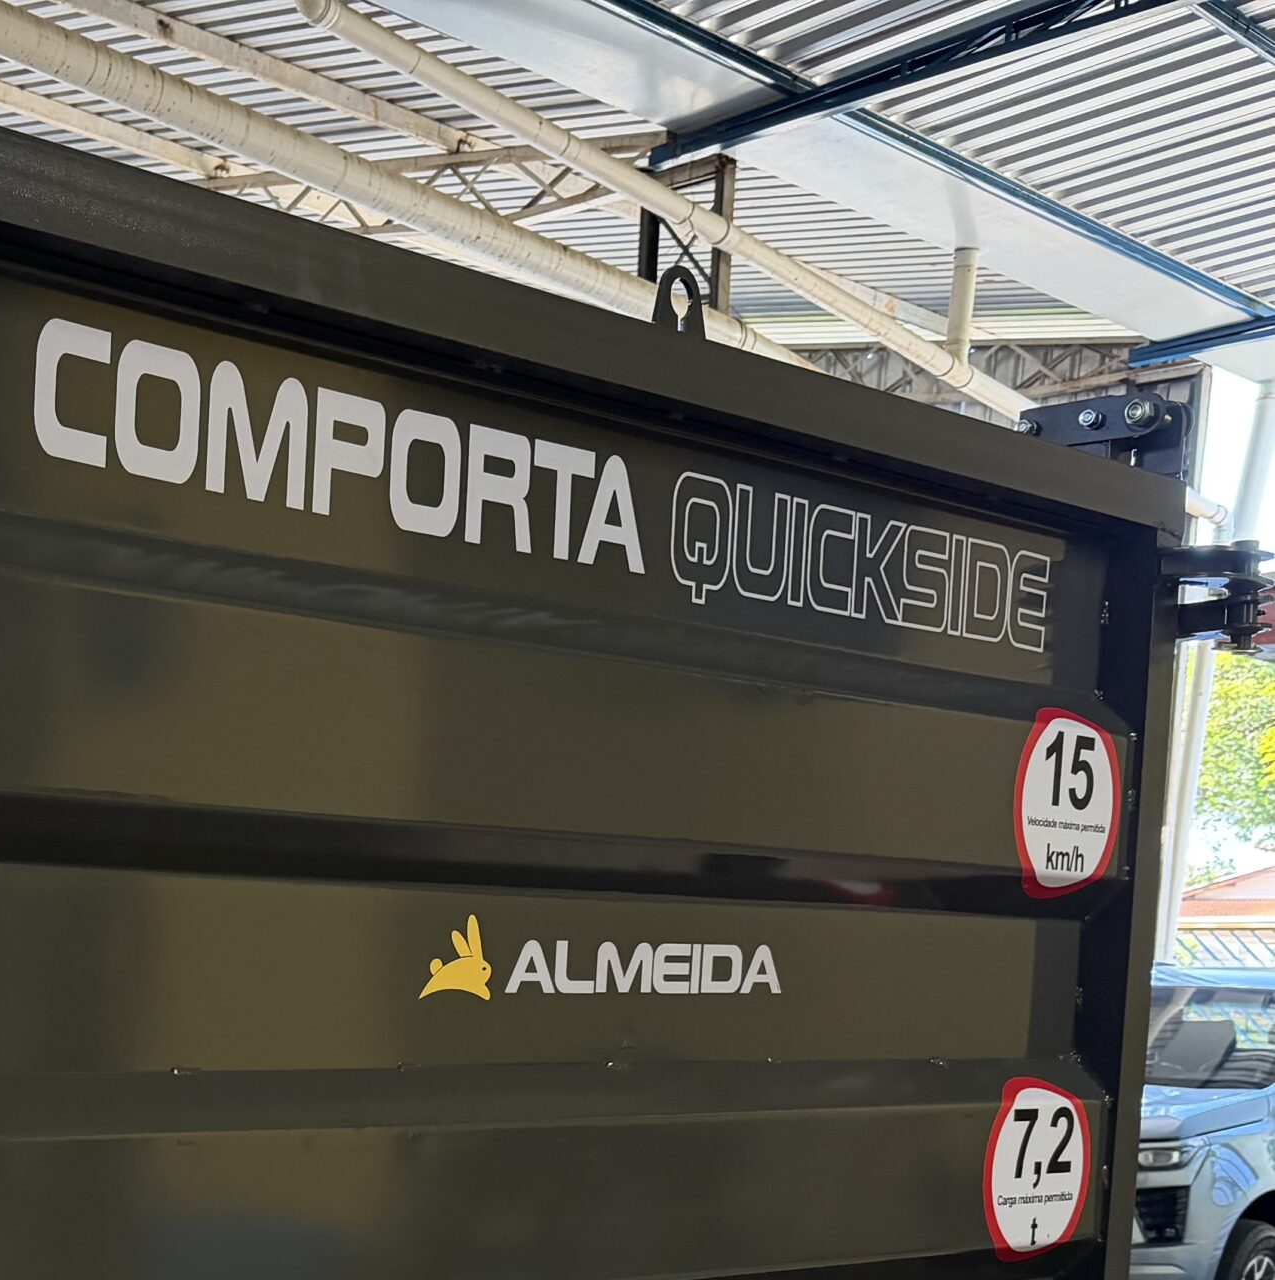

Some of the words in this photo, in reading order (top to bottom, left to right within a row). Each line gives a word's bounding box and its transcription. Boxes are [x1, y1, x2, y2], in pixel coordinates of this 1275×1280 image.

[33, 318, 646, 575] COMPORTA
[670, 471, 1051, 653] QUICKSIDE
[1045, 731, 1096, 811] 15
[1027, 816, 1058, 829] Velocidade
[1058, 820, 1080, 831] máxima
[1080, 822, 1106, 834] permitida
[1045, 843, 1085, 873] km/h
[504, 939, 781, 994] ALMEIDA
[1013, 1106, 1075, 1189] 7,2
[997, 1195, 1017, 1208] Carga
[1018, 1193, 1043, 1206] máxima
[1044, 1191, 1073, 1205] permitida
[1030, 1216, 1039, 1246] t
